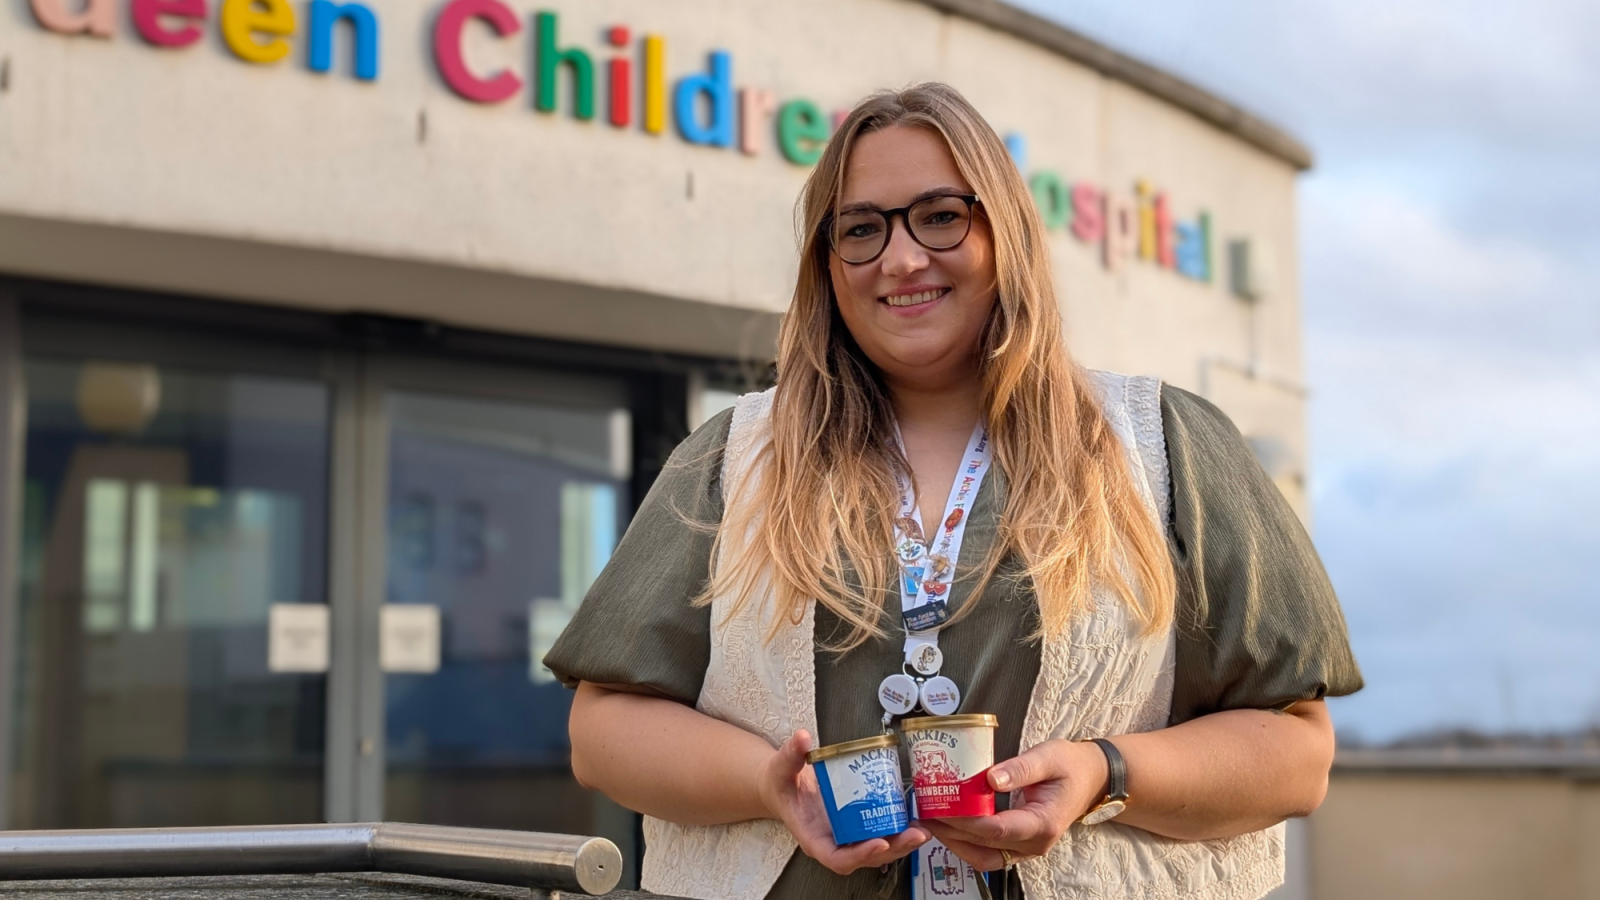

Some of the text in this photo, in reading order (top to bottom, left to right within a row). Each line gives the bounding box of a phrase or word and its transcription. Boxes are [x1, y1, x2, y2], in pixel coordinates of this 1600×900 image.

[433, 0, 848, 166] Childre
[1004, 133, 1212, 282] ospital
[956, 460, 982, 501] The Archie
